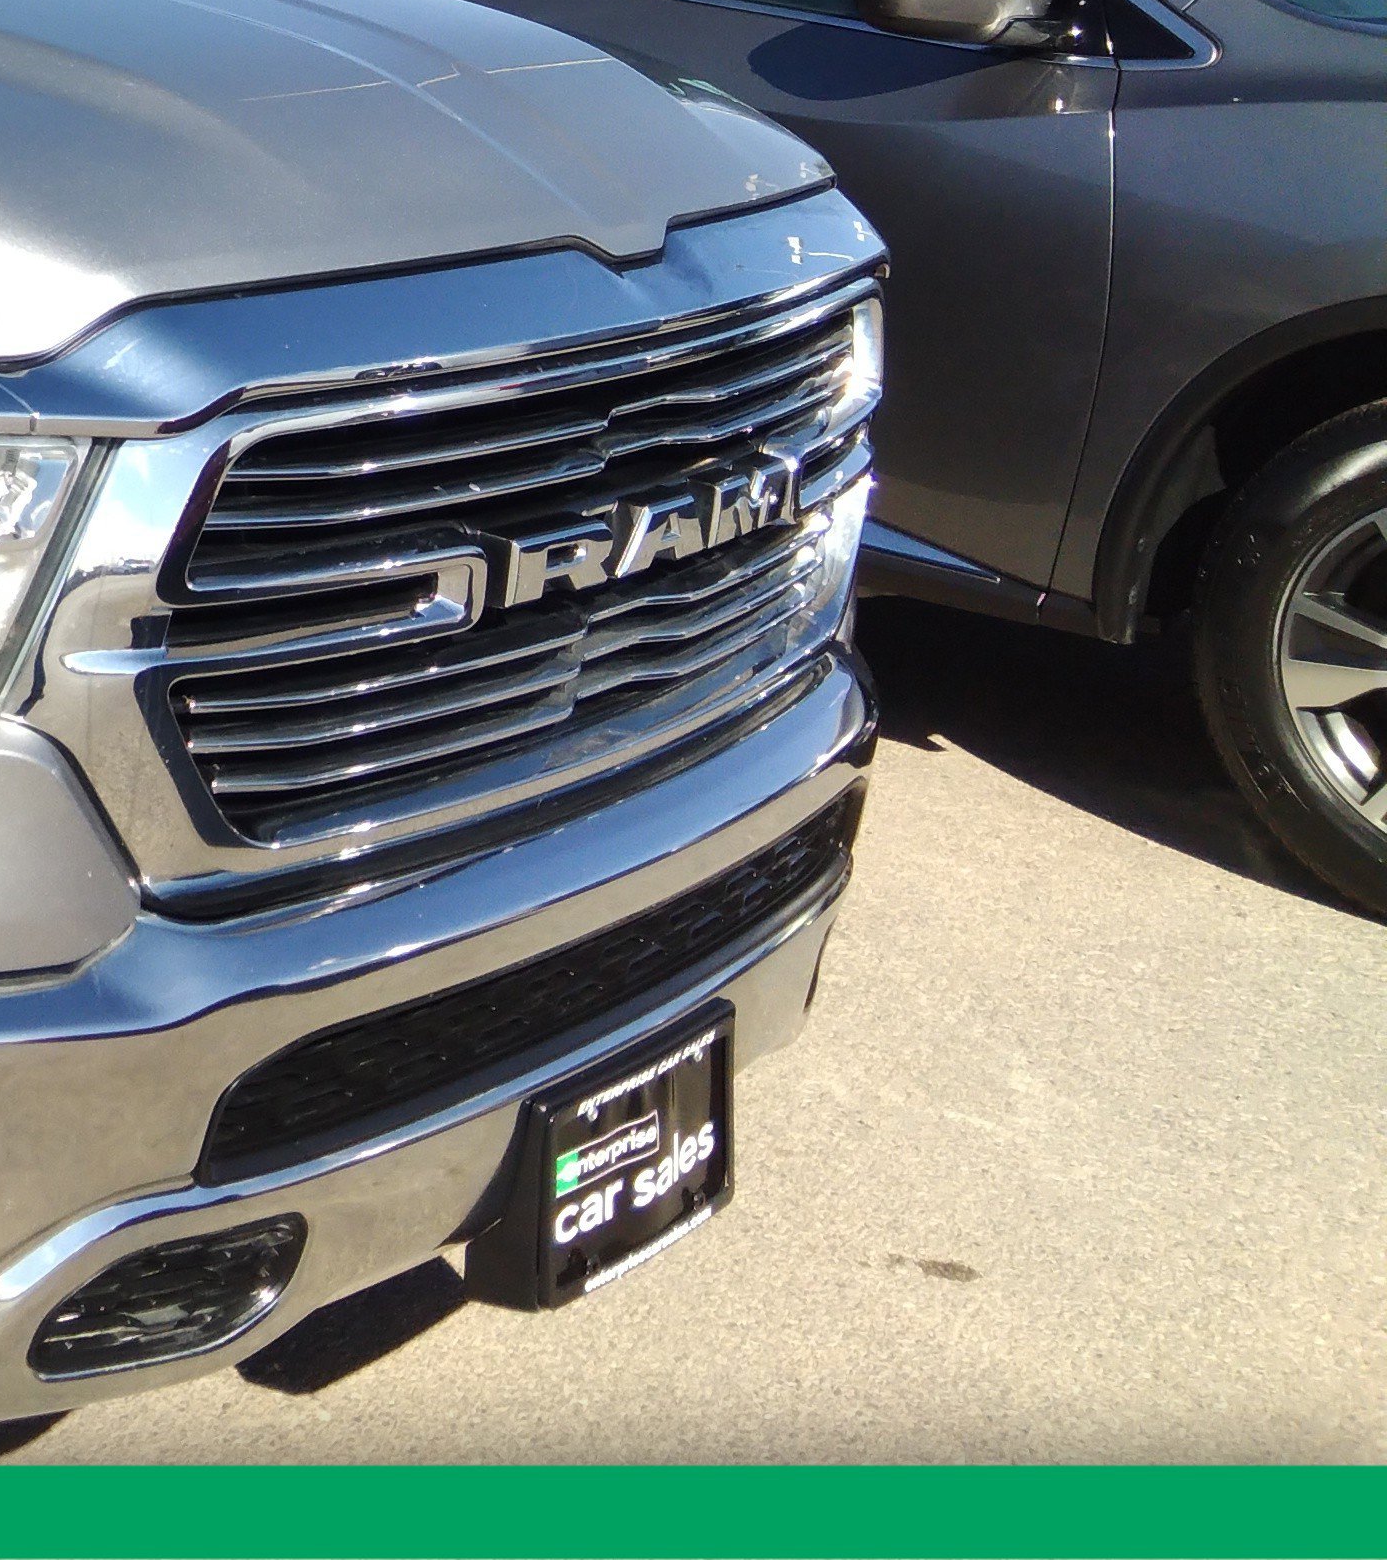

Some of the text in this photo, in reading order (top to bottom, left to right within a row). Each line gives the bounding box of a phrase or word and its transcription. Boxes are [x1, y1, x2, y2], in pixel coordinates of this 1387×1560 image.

[504, 450, 799, 608] RAM
[555, 1121, 716, 1244] car sales
[557, 1124, 657, 1182] enterprise
